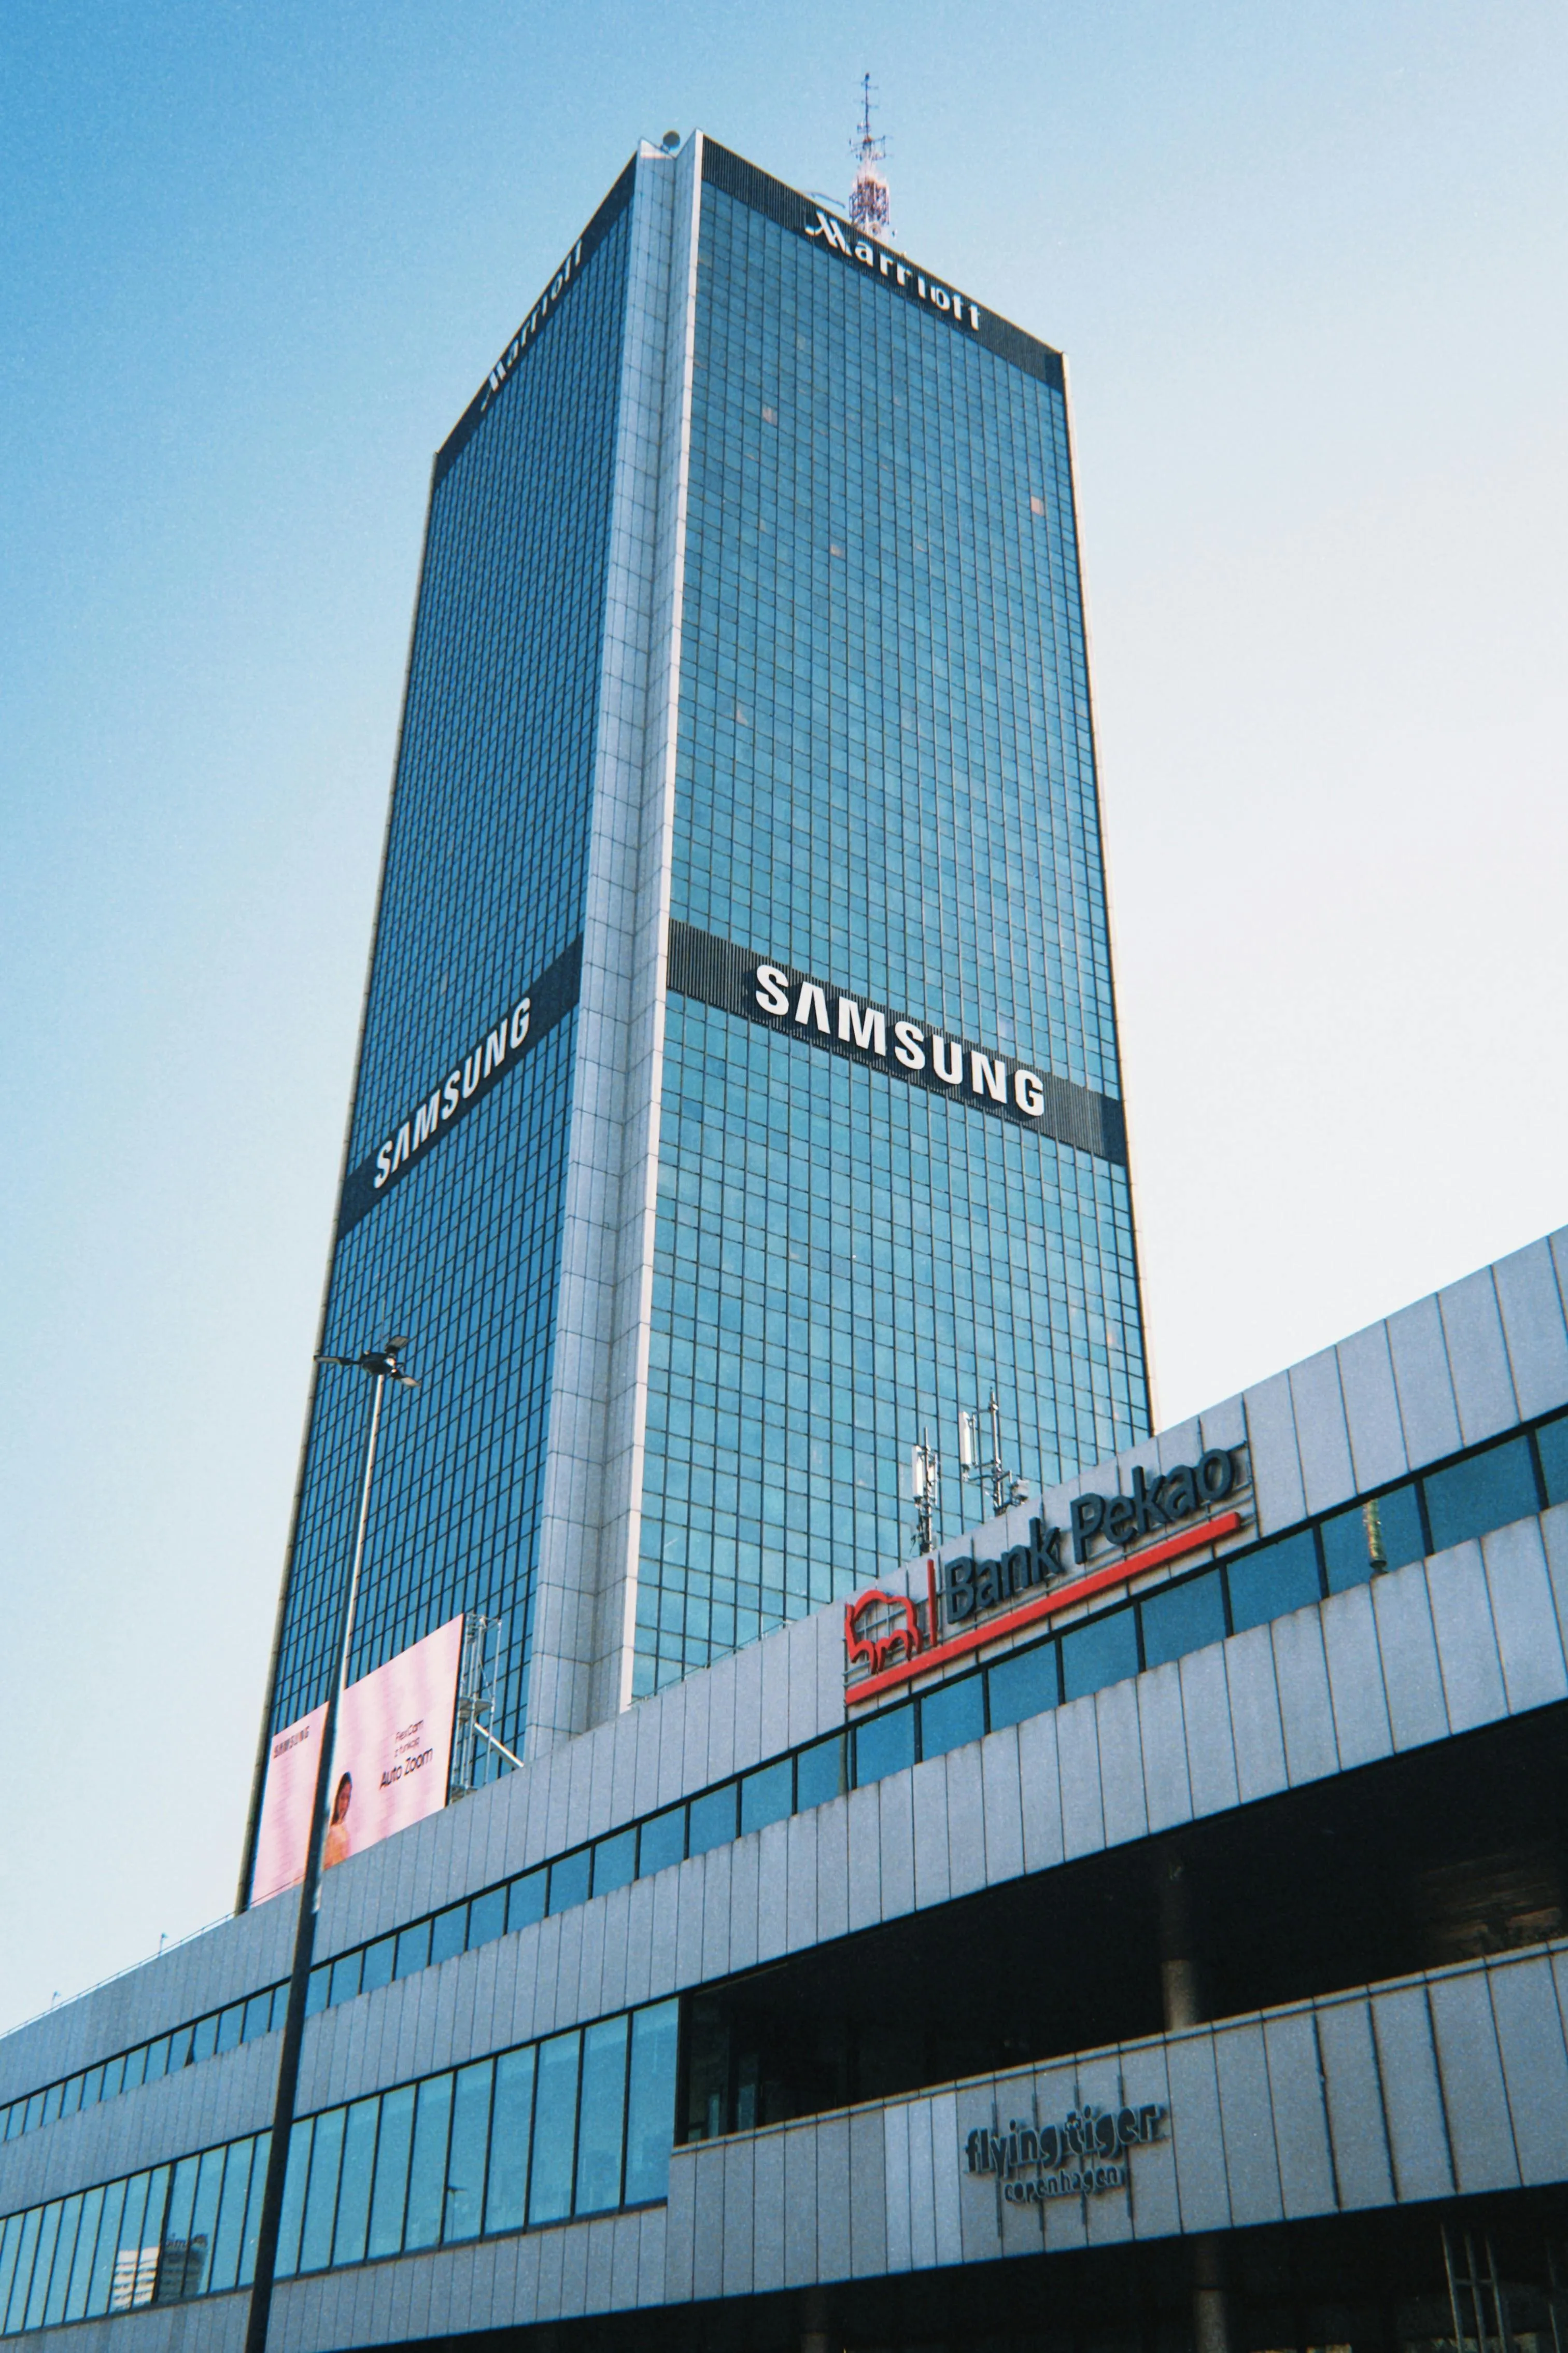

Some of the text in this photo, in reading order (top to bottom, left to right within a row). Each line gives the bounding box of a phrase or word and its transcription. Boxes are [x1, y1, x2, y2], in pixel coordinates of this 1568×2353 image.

[805, 209, 980, 331] Marriott
[374, 997, 530, 1188] SAMSUNG
[755, 964, 1044, 1116] SAMSUNG
[944, 1448, 1236, 1624] Bank Pekao
[274, 1726, 309, 1759] SAMSUNG
[379, 1747, 433, 1789] Auto Zoom
[1004, 2165, 1118, 2203] copenhagen
